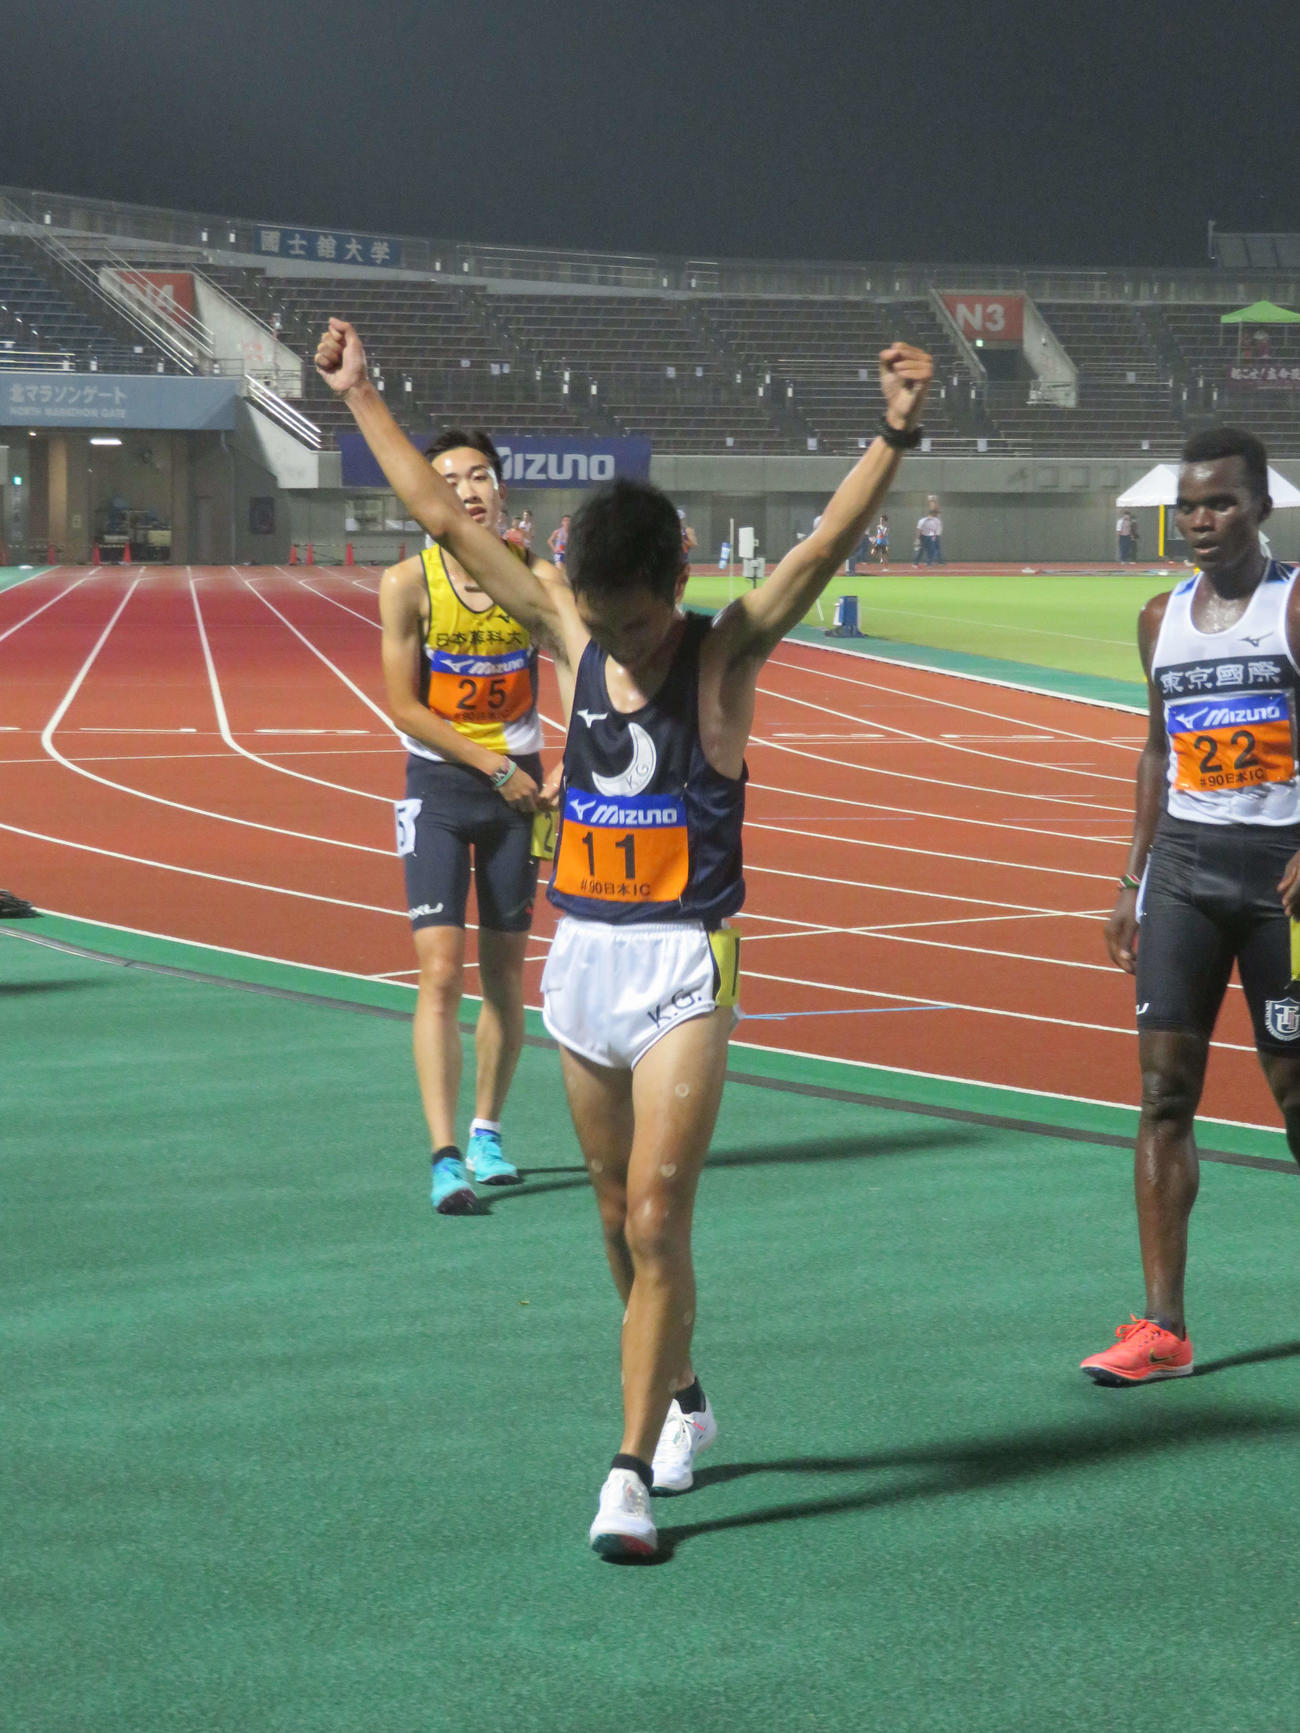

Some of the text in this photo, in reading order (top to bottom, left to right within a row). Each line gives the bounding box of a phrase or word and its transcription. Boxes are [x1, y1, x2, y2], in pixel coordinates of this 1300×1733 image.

[955, 303, 1005, 332] N3
[1160, 661, 1281, 694] 東京國際
[456, 678, 507, 712] 25
[1194, 730, 1260, 774] 22
[582, 831, 636, 880] 11
